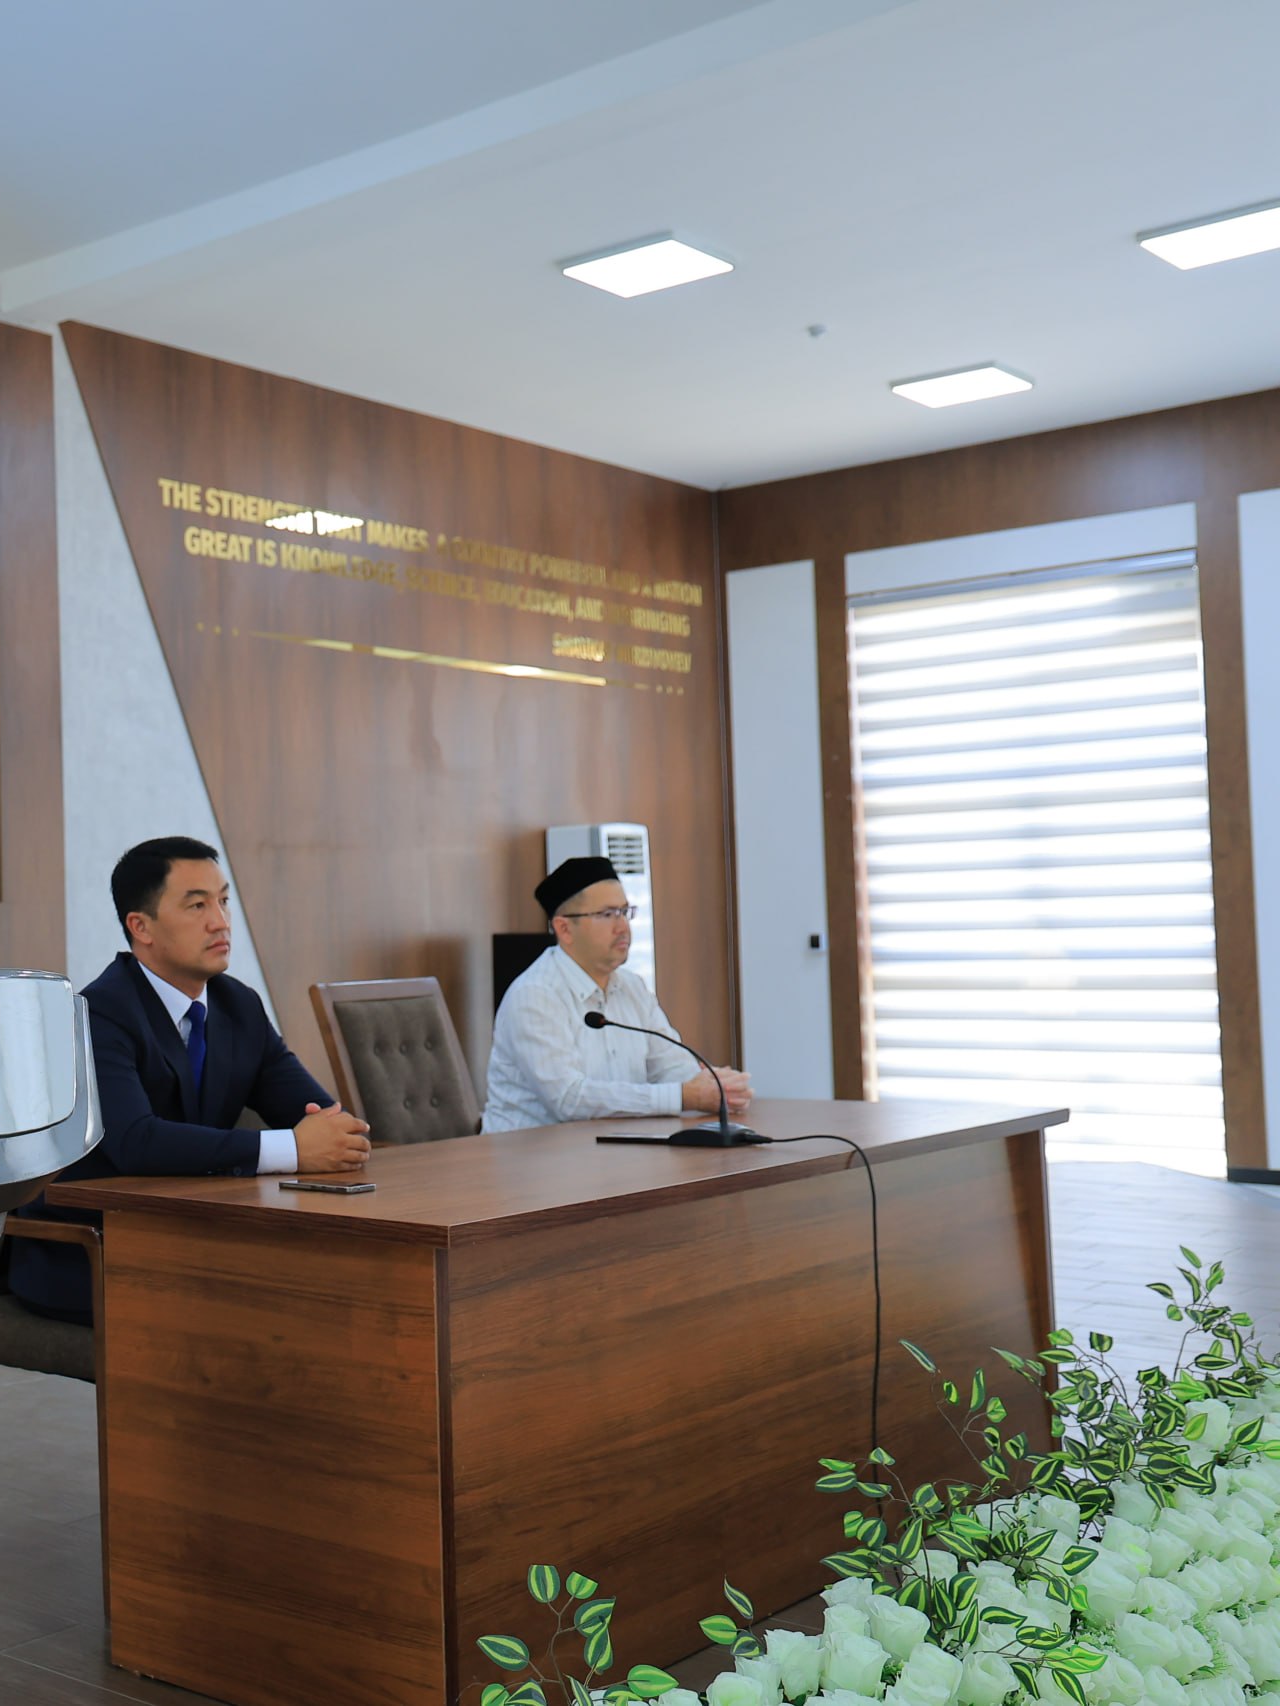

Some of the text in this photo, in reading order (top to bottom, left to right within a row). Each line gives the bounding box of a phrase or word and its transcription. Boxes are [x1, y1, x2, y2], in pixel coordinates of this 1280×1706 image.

[158, 478, 201, 512] THE
[205, 487, 313, 535] STRENG
[367, 520, 429, 551] MAKES
[184, 526, 253, 562] GREAT
[256, 538, 277, 568] IS
